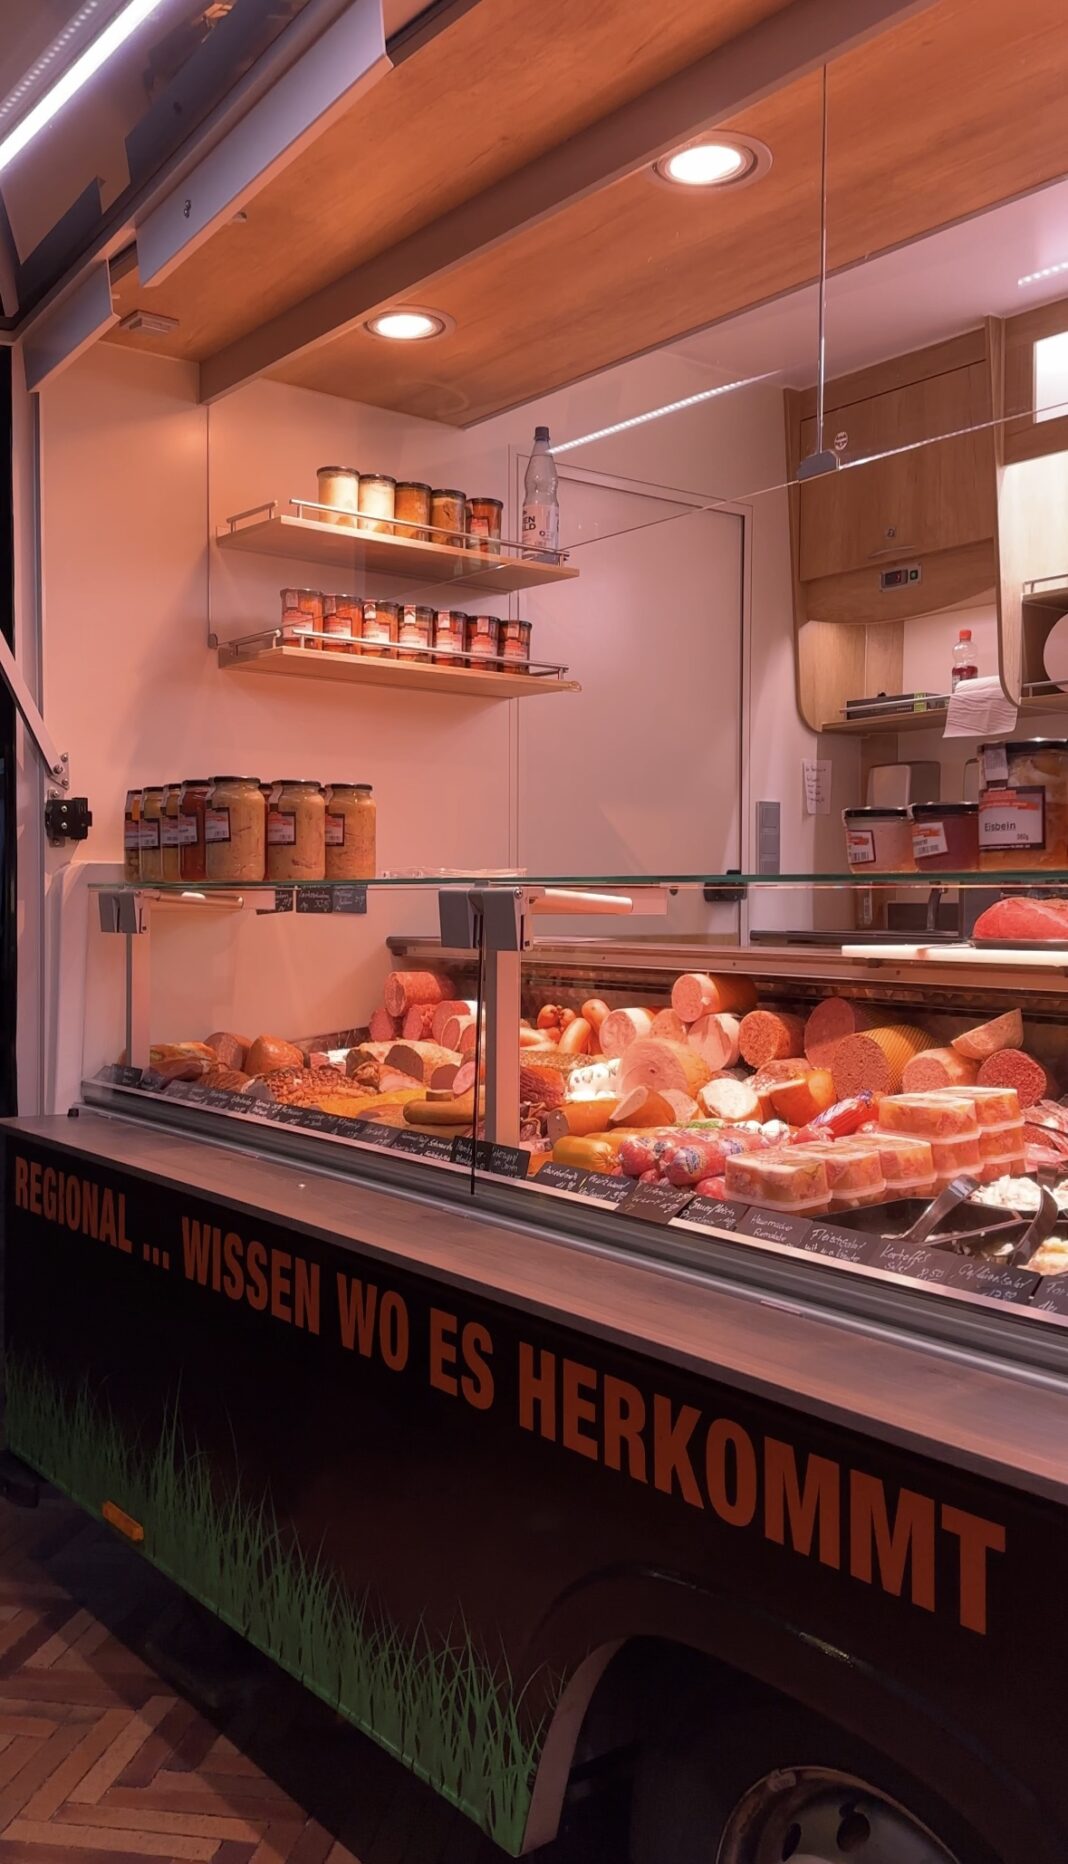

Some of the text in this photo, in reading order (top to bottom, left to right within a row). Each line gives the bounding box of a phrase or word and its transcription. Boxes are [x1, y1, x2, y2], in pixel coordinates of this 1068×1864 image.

[984, 821, 1016, 833] Eisbein
[15, 1155, 133, 1255] REGIONAL
[181, 1214, 320, 1336] WISSEN
[336, 1271, 410, 1373] WO
[429, 1306, 495, 1411] ES
[518, 1340, 1006, 1636] HERKOMMT
